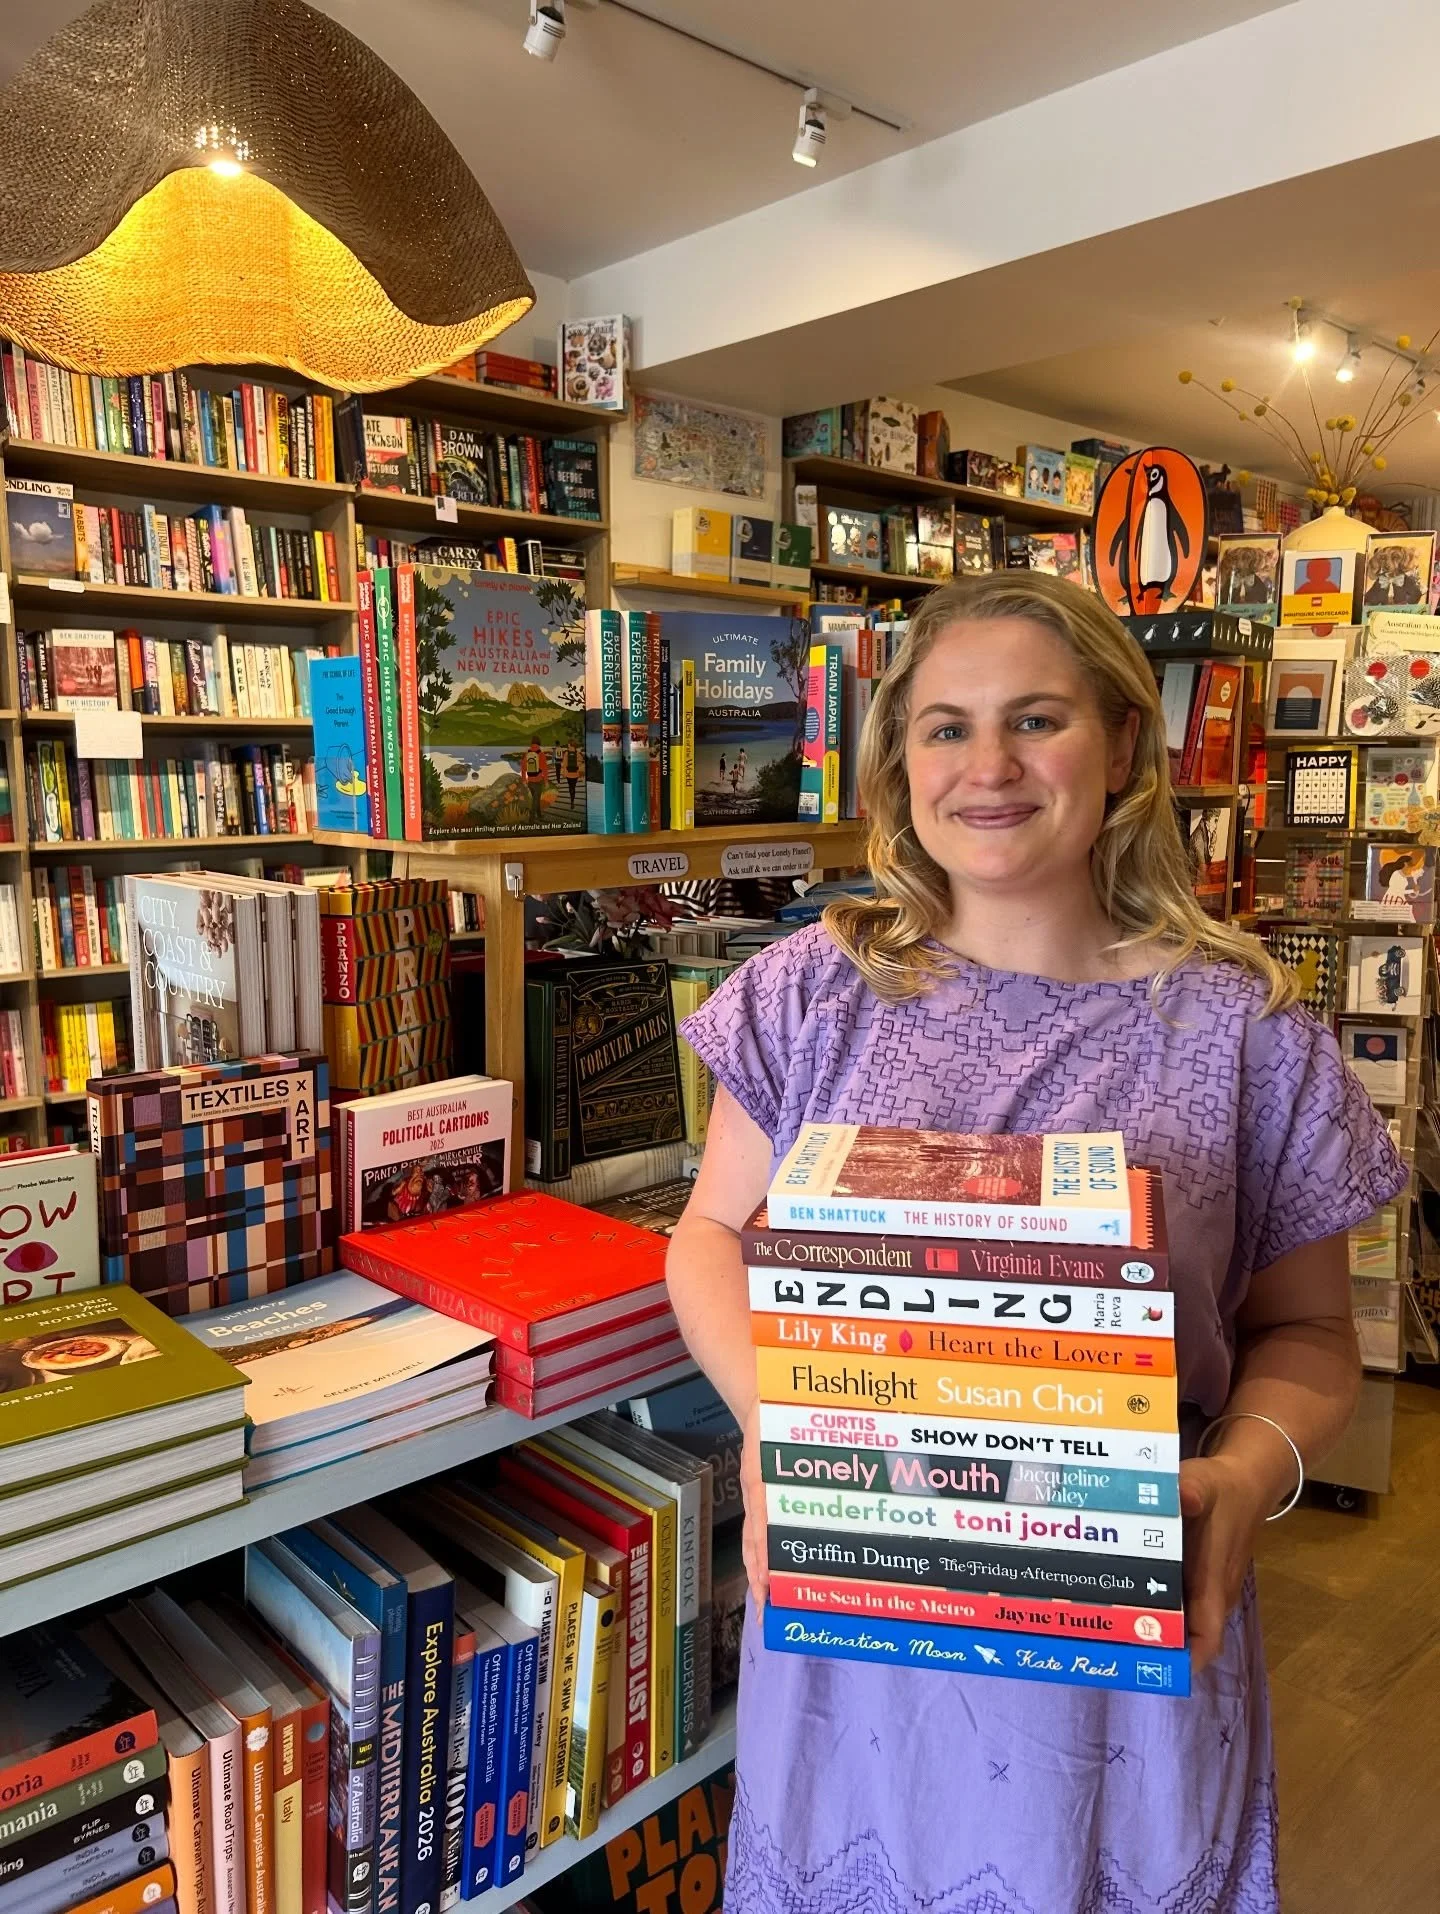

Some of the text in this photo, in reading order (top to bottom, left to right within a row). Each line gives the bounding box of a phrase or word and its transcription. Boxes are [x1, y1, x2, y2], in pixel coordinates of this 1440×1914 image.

[32, 405, 42, 440] CANTO
[277, 396, 288, 446] SUNSTRUCK
[450, 430, 474, 444] DAN
[442, 440, 484, 460] BROWN
[75, 508, 86, 542] RABBITS
[437, 545, 480, 560] GARRY
[487, 610, 521, 626] EPIC
[382, 634, 390, 662] EPIC
[474, 626, 534, 648] HIKES
[712, 632, 758, 646] ULTIMATE
[457, 660, 550, 676] NEW ZEALAND
[470, 648, 538, 661] AUSTRALIA
[704, 652, 766, 678] Family
[384, 666, 392, 702] HIKES
[604, 631, 615, 718] EXPERIENCES
[696, 678, 774, 703] Holidays
[828, 654, 838, 734] TRAIN JAPAN
[708, 708, 761, 718] AUSTRALIA
[1296, 756, 1348, 768] HAPPY
[1293, 815, 1345, 824] BIRTHDAY
[632, 857, 686, 875] TRAVEL
[726, 846, 812, 860] Can't find your Lonely Planet?
[728, 866, 740, 876] Ask
[741, 865, 753, 874] staff
[754, 865, 760, 873] &
[782, 862, 797, 871] order
[140, 895, 180, 932] CITY,
[142, 928, 214, 973] COAST &
[336, 922, 351, 999] PRANZO
[144, 960, 227, 1011] COUNTRY
[579, 1036, 633, 1082] FOREVER
[634, 1011, 668, 1049] PARIS
[185, 1078, 290, 1112] TEXTILES
[407, 1100, 468, 1122] BEST AUSTRALIAN
[295, 1098, 310, 1155] ART
[382, 1110, 490, 1147] POLITICAL CARTOONS
[430, 1138, 445, 1151] 2025
[786, 1131, 832, 1186] BEN SHATTUCK
[17, 1175, 76, 1190] Phoebe Waller-Bridge
[1053, 1141, 1080, 1196] THE HISTORY
[1088, 1146, 1118, 1191] OF SOUND
[790, 1206, 1068, 1232] BEN SHATTUCK THE HISTORY OF SOUND
[754, 1238, 1105, 1280] The Correspondent Virginia Evans
[4, 1296, 109, 1323] SOMETHING
[39, 1306, 119, 1328] NOTHING
[81, 1300, 113, 1314] from
[219, 1300, 287, 1322] ULTIMATE
[774, 1279, 1072, 1324] ENDLING
[1094, 1292, 1105, 1328] Maria
[1110, 1296, 1122, 1328] Reva
[206, 1300, 328, 1338] Beaches
[244, 1314, 326, 1342] AUSTRALIA
[778, 1318, 1123, 1366] Lily King Heart the Lover
[323, 1360, 425, 1399] CELESTE MITCHELL
[792, 1364, 1104, 1416] Flashlight Susan Choi
[790, 1426, 898, 1448] SITTENFELD
[810, 1413, 876, 1432] CURTIS
[911, 1428, 1109, 1457] SHOW DON'T TELL
[775, 1448, 1000, 1494] Lonely Mouth
[1014, 1464, 1111, 1488] Jacqueline
[1034, 1482, 1089, 1508] Maley
[778, 1494, 1120, 1544] tenderfoot toni jordan
[780, 1540, 1136, 1590] Griffin Dunne The Friday Afternoon Club
[684, 1516, 696, 1735] KINFOLK WILDERNESS
[793, 1586, 1114, 1632] The Sea in the Metro Jayne Tuttle
[629, 1541, 648, 1726] THE INTREPID LIST
[784, 1622, 1120, 1679] Destination Moon Kate Reid
[554, 1602, 578, 1789] PLACES WE SWIM CALIFORNIA
[485, 1654, 502, 1784] Off the Leash in Australia
[416, 1620, 444, 1862] Explore Australia 2026
[222, 1750, 234, 1864] Ultimate Road Trips:
[378, 1679, 404, 1914] THE MEDITERRANEAN
[72, 1822, 111, 1844] BYRNES
[80, 1817, 102, 1832] FLIP
